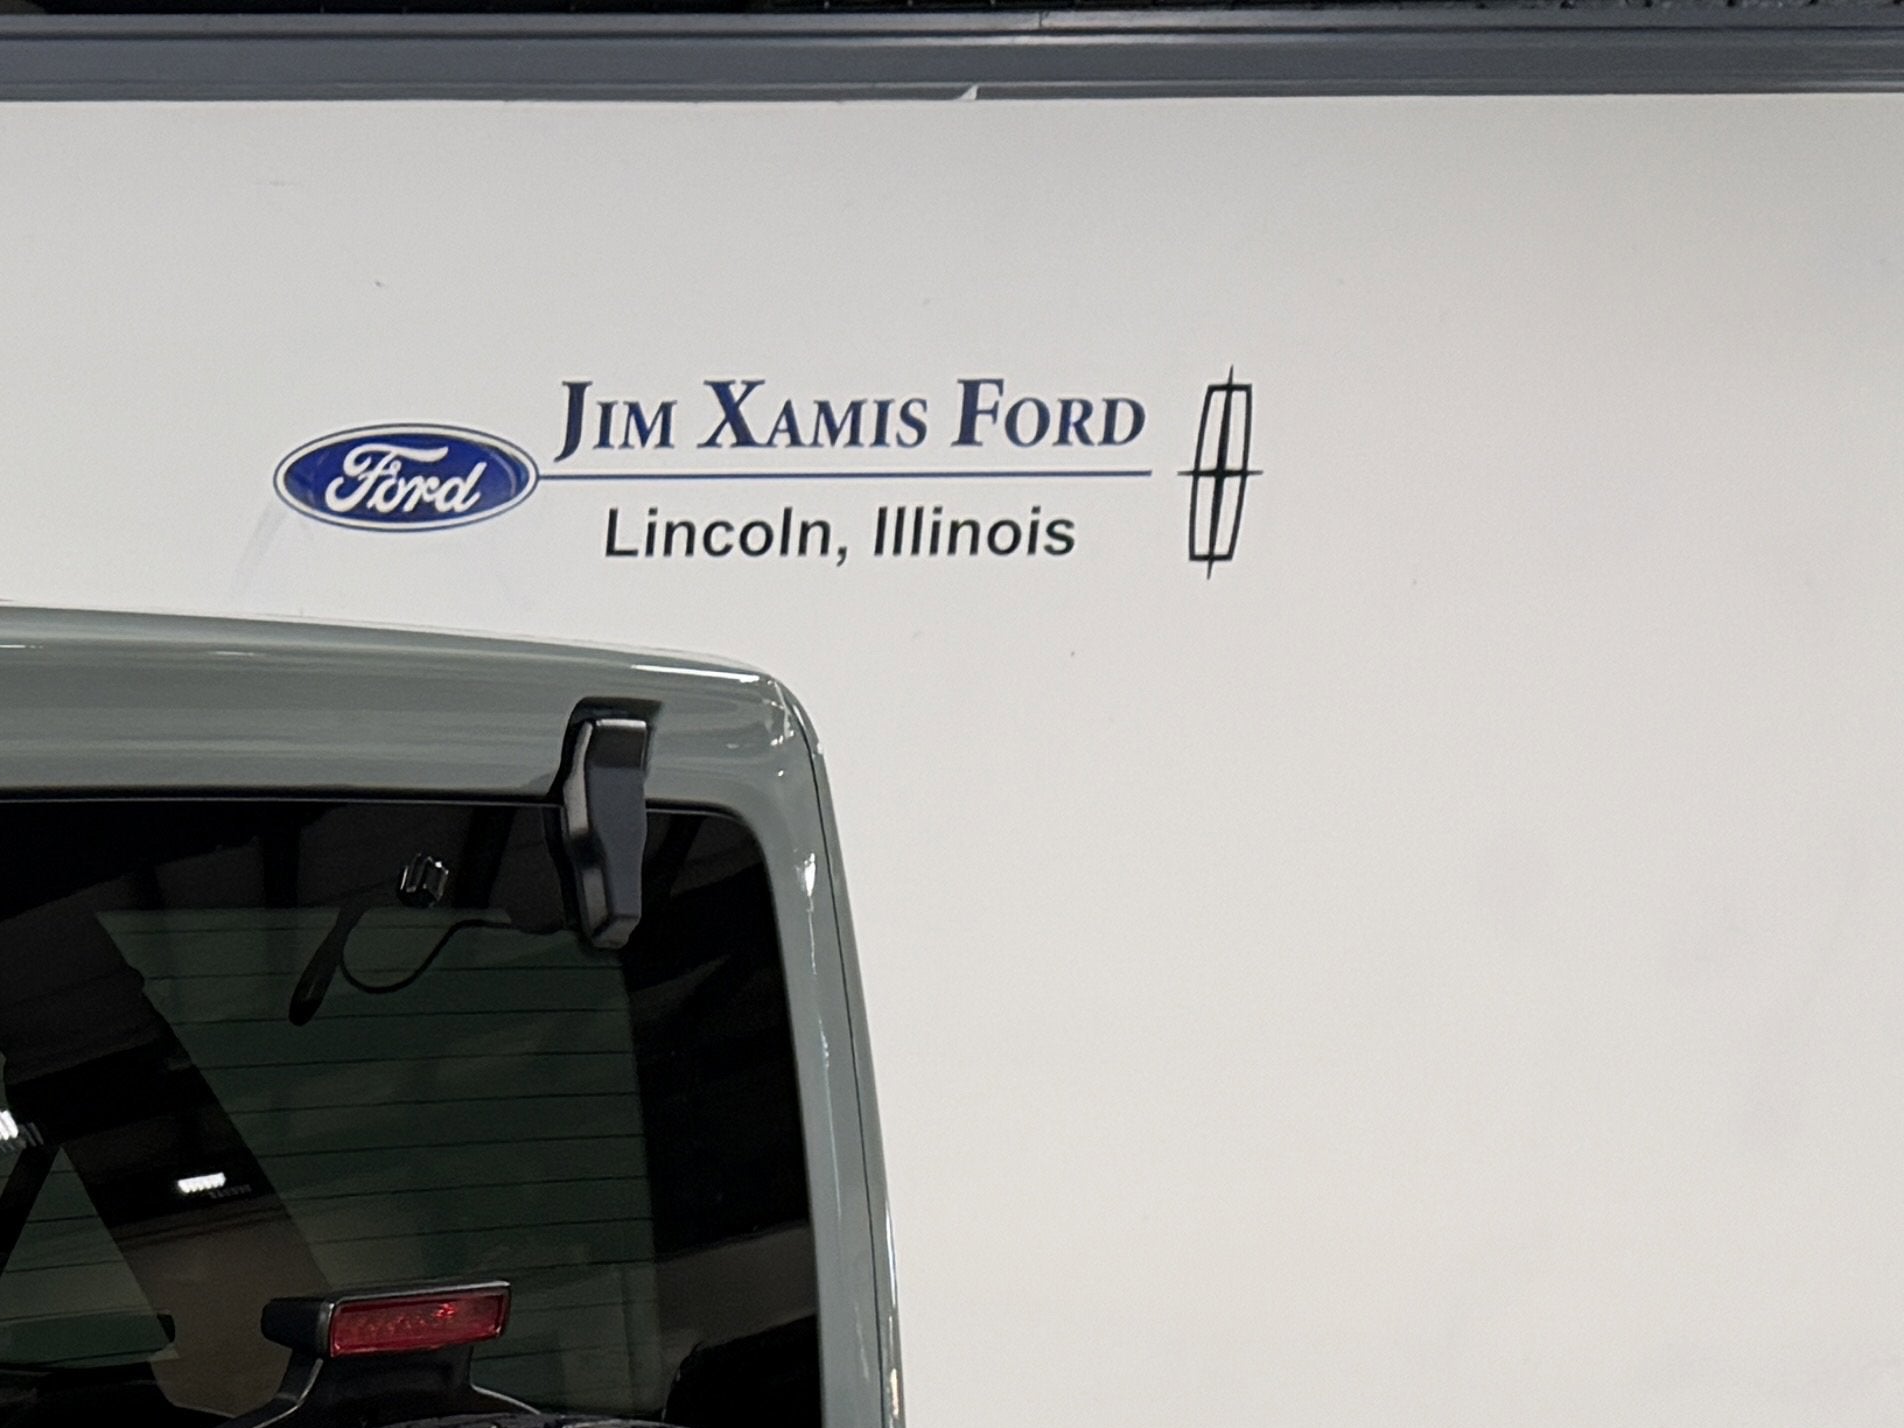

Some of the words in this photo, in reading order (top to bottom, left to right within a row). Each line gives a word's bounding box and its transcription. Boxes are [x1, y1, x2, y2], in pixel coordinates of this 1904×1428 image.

[554, 380, 676, 463] JIM
[700, 379, 928, 450] XAMIS
[951, 378, 1146, 448] FORD
[325, 443, 482, 514] Ford
[604, 506, 848, 567] Lincoln,
[874, 506, 1076, 557] Illinois
